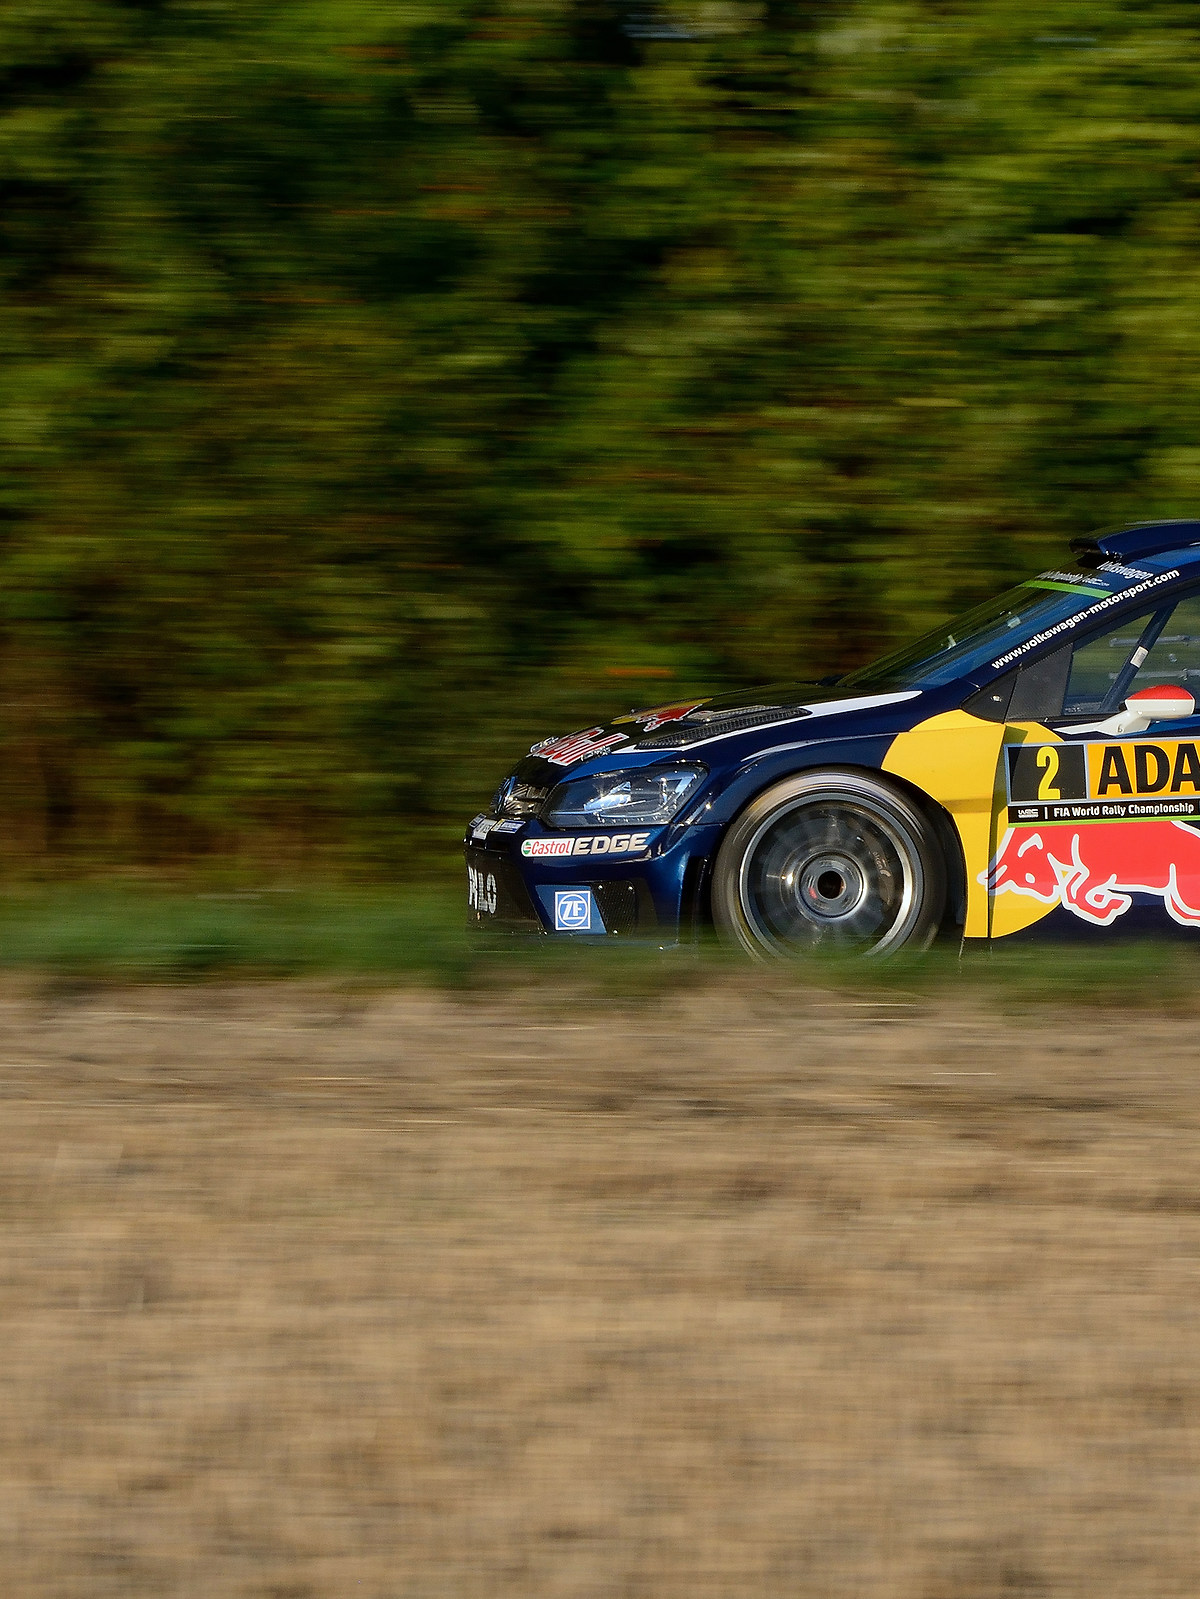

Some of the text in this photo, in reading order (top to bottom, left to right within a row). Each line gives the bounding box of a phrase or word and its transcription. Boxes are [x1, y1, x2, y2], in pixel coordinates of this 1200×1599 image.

[991, 568, 1181, 670] www.volkswagen-motorsport.com
[1036, 746, 1061, 800] 2
[1053, 802, 1194, 818] FIA World Rally Championship
[531, 832, 651, 856] Castrol EDGE
[558, 897, 589, 925] ZF
